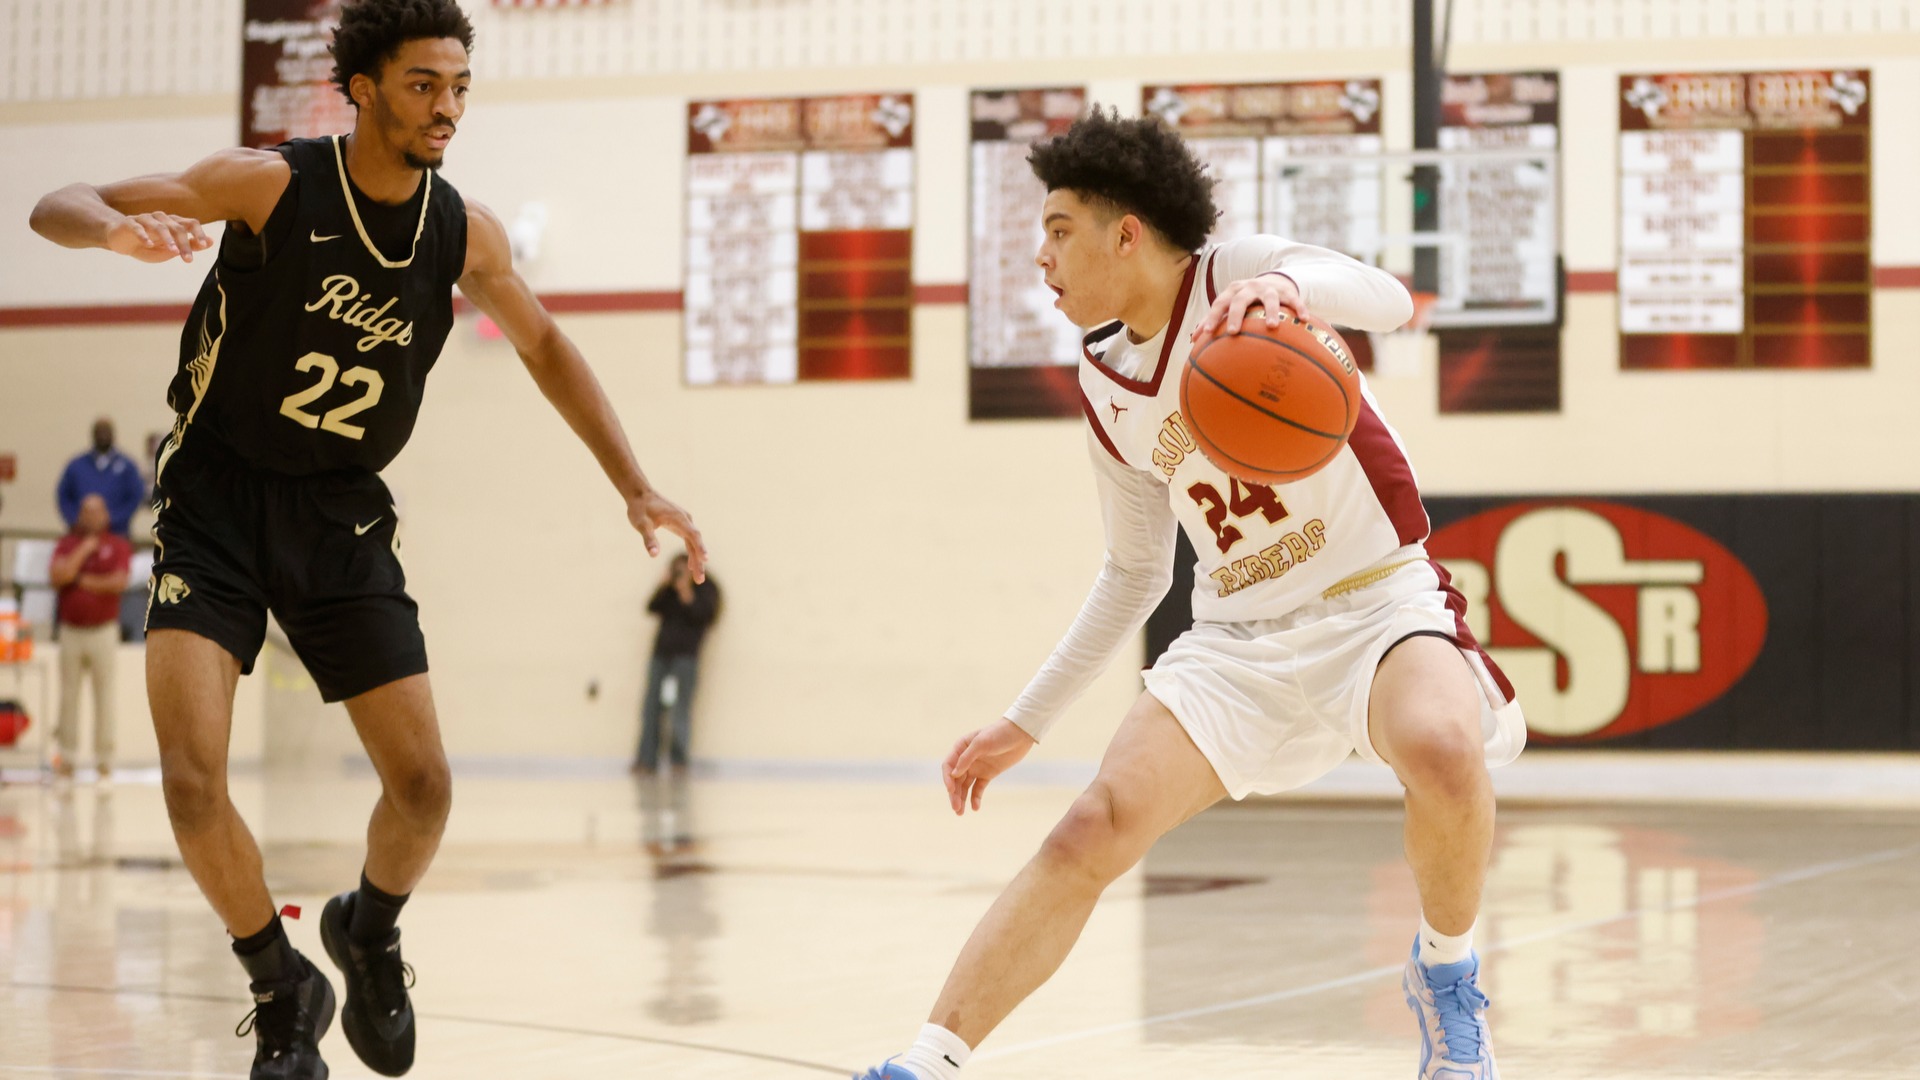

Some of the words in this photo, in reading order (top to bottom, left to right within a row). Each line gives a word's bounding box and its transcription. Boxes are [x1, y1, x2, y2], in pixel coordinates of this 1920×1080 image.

[279, 351, 385, 440] 22
[1186, 472, 1293, 556] 24
[1209, 518, 1326, 598] RIDERS
